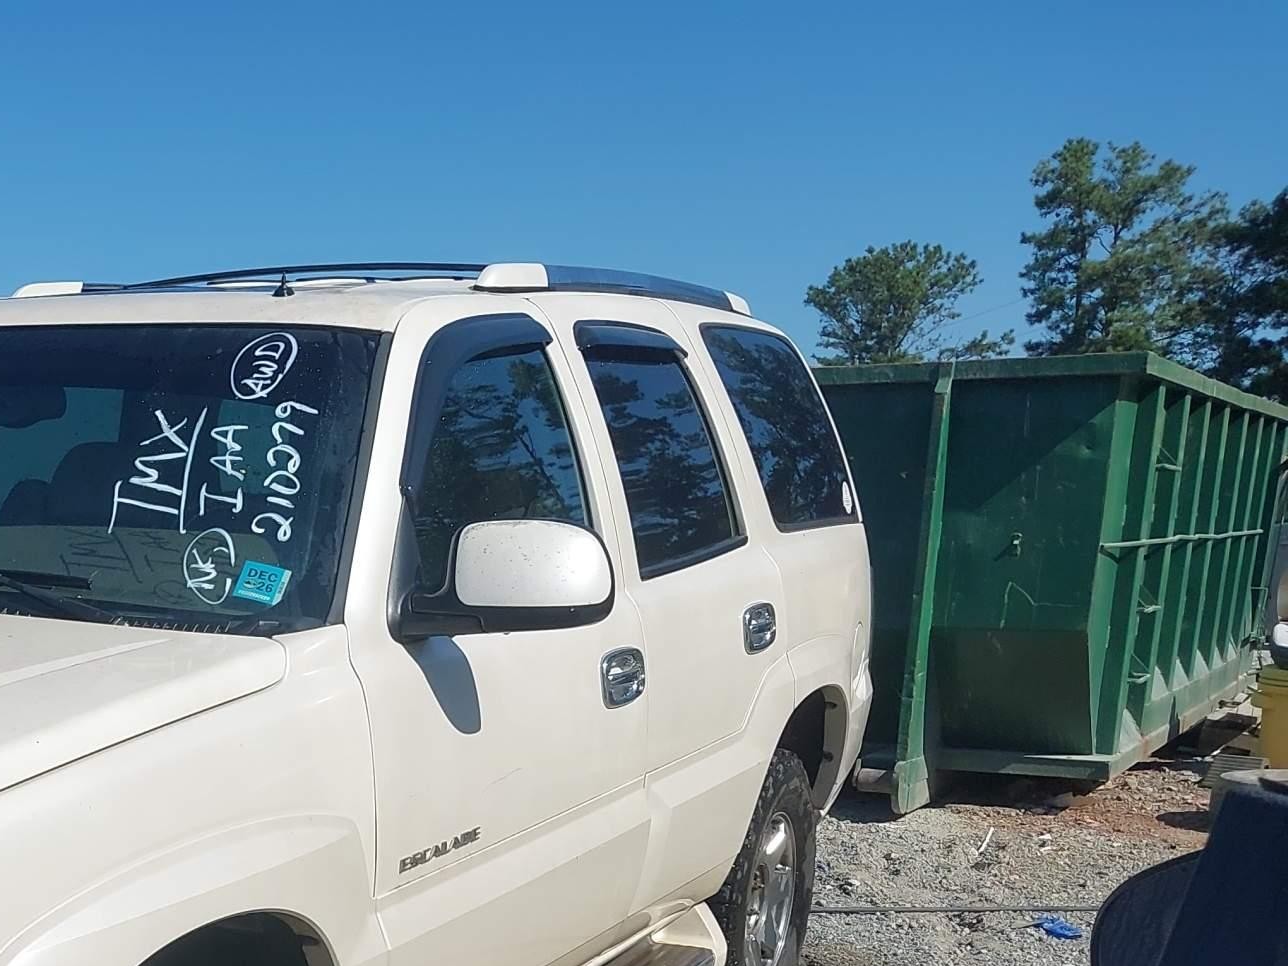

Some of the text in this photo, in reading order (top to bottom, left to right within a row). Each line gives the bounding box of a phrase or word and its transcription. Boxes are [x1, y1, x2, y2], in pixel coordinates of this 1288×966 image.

[241, 341, 285, 398] AWD
[199, 424, 249, 515] IAA
[251, 401, 320, 542] 210279
[247, 567, 278, 583] DEC
[256, 581, 274, 593] 26
[399, 826, 481, 874] ESCALADE
